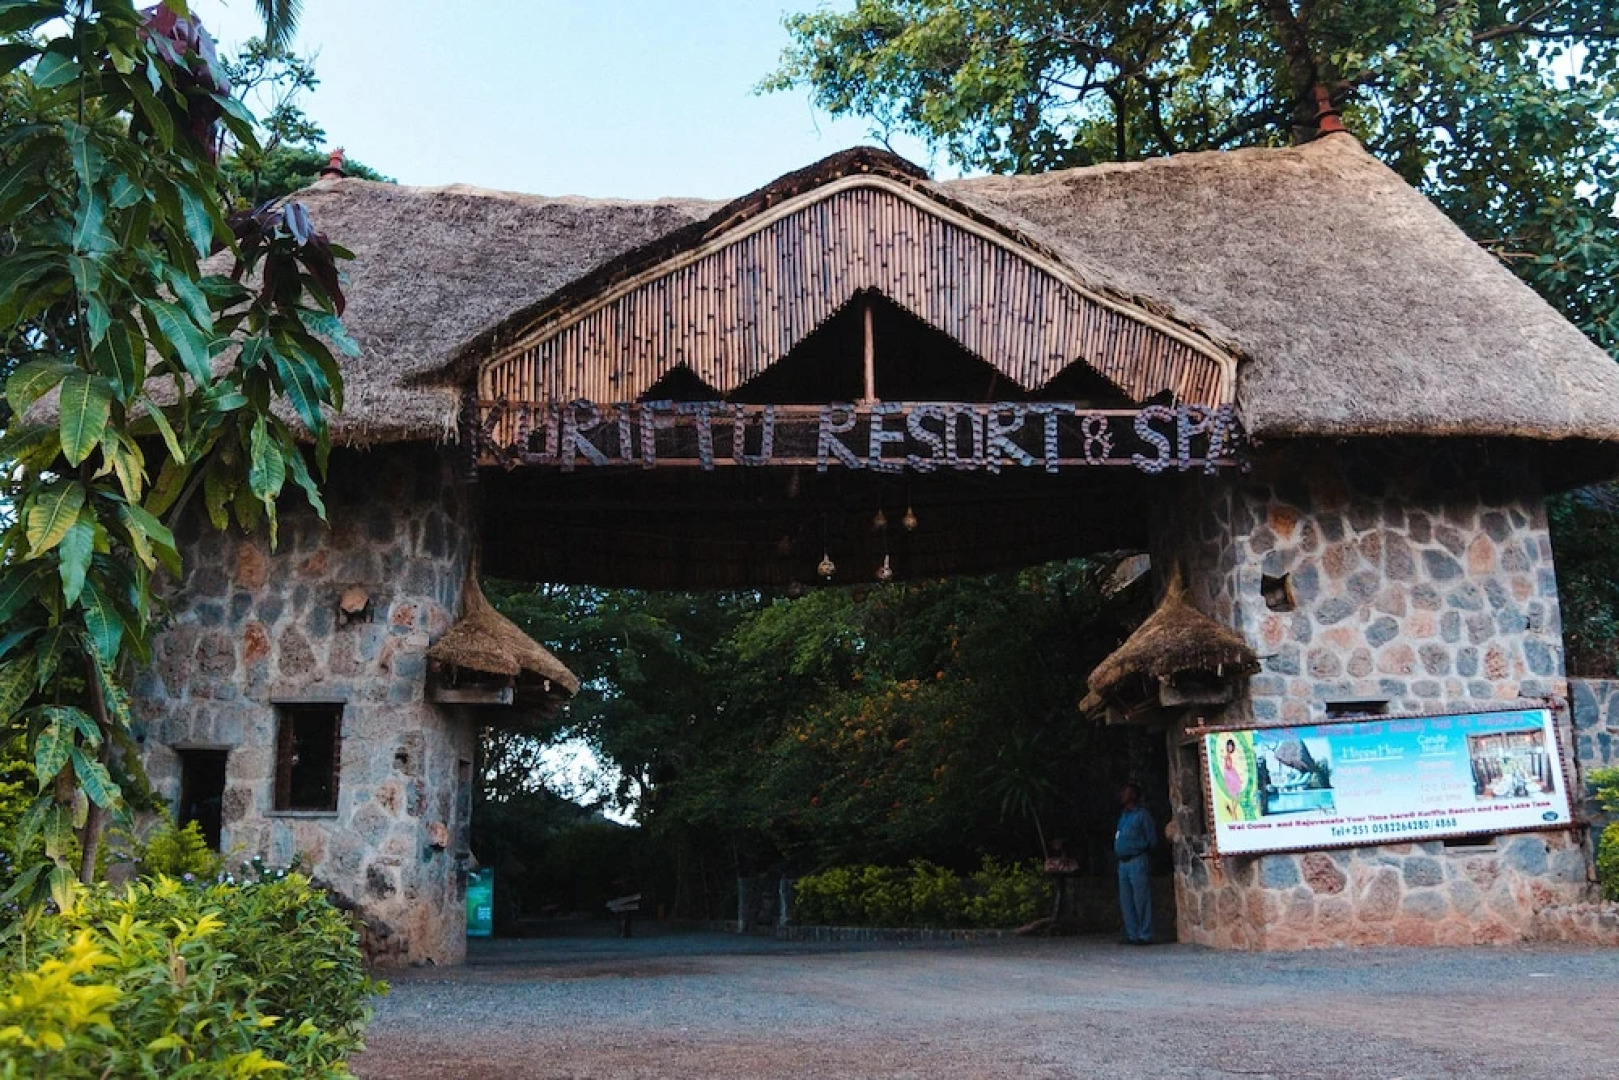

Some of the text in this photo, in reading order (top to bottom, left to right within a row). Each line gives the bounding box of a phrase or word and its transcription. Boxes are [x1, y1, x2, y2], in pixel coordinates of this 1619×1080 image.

[816, 400, 1076, 474] RESORT
[1131, 403, 1247, 474] SPA
[1346, 815, 1366, 823] Your
[1449, 806, 1475, 815] Resort
